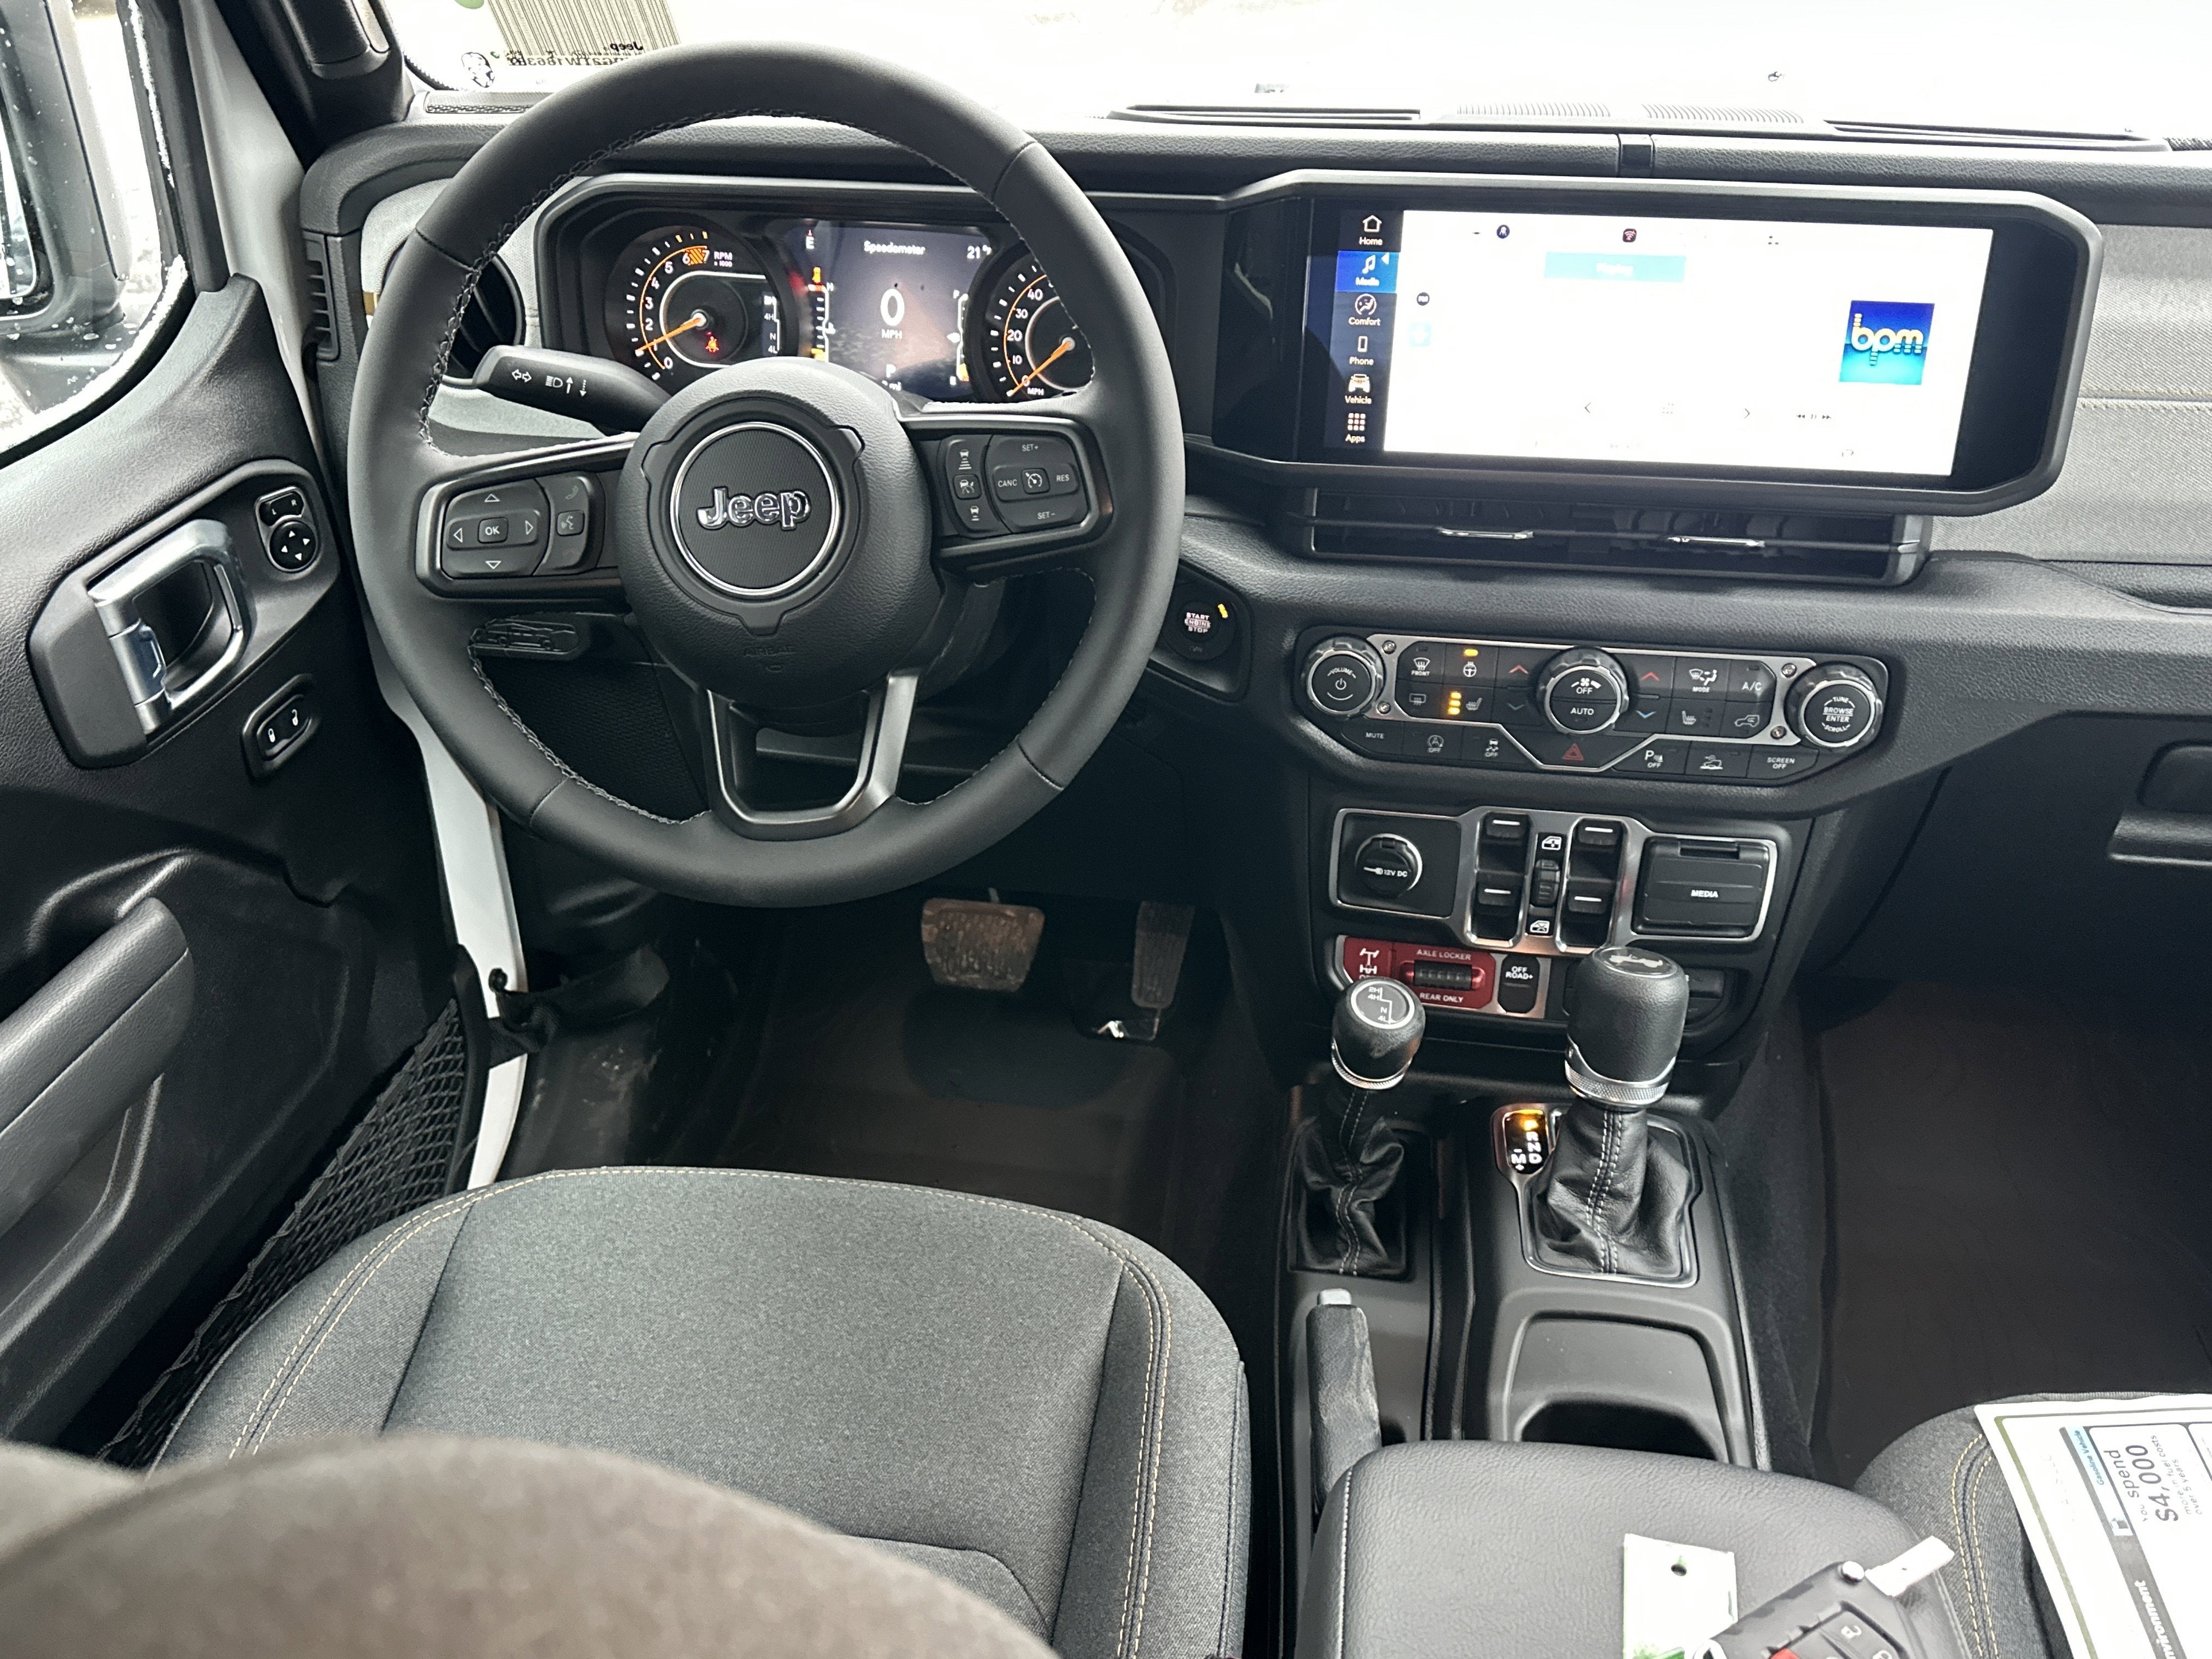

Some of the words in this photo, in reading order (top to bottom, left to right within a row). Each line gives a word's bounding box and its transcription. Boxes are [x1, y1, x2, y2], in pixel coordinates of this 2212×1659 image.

[1359, 237, 1383, 246] Home
[864, 240, 926, 255] Speedometer
[682, 252, 691, 264] 6
[702, 250, 710, 262] 7
[714, 251, 732, 261] RPM
[664, 261, 673, 274] 5
[651, 276, 659, 290] 4
[1027, 288, 1043, 301] 40
[645, 297, 653, 310] 3
[880, 289, 905, 326] 0
[1015, 308, 1028, 319] 30
[646, 318, 653, 331] 2
[1348, 317, 1381, 326] Comfort
[881, 329, 903, 340] MPH
[1007, 330, 1023, 342] 20
[1851, 313, 1923, 366] bpm
[664, 357, 673, 369] 0
[1012, 355, 1023, 365] 10
[1349, 357, 1374, 366] Phone
[1027, 387, 1044, 396] MPH
[1345, 396, 1372, 405] Vehicle
[1345, 433, 1365, 443] Apps
[997, 479, 1018, 488] CANC
[696, 486, 811, 531] Jeep
[485, 526, 500, 536] OK
[1186, 612, 1210, 620] START
[1330, 667, 1353, 676] VOLUME
[1576, 687, 1593, 695] OFF
[1741, 681, 1762, 691] A/C
[1570, 707, 1594, 716] AUTO
[1824, 706, 1854, 715] BROWSE
[1825, 715, 1850, 723] ENTER
[1824, 724, 1848, 733] SCROLL
[1767, 757, 1796, 765] SCREEN
[1691, 889, 1719, 899] MEDIA
[1417, 949, 1437, 957] AXLE
[1438, 951, 1472, 961] LOCKER
[1505, 971, 1534, 980] ROAD+
[1419, 992, 1442, 1001] REAR
[1442, 994, 1464, 1003] ONLY
[1526, 1131, 1539, 1141] R
[1527, 1142, 1542, 1152] N
[1511, 1154, 1527, 1164] M
[1528, 1153, 1543, 1164] D
[2150, 1435, 2166, 1458] costs
[2103, 1449, 2140, 1498] spend
[2171, 1459, 2189, 1483] years
[2125, 1444, 2179, 1522] $4,000
[2177, 1490, 2193, 1515] more
[2188, 1494, 2203, 1515] over
